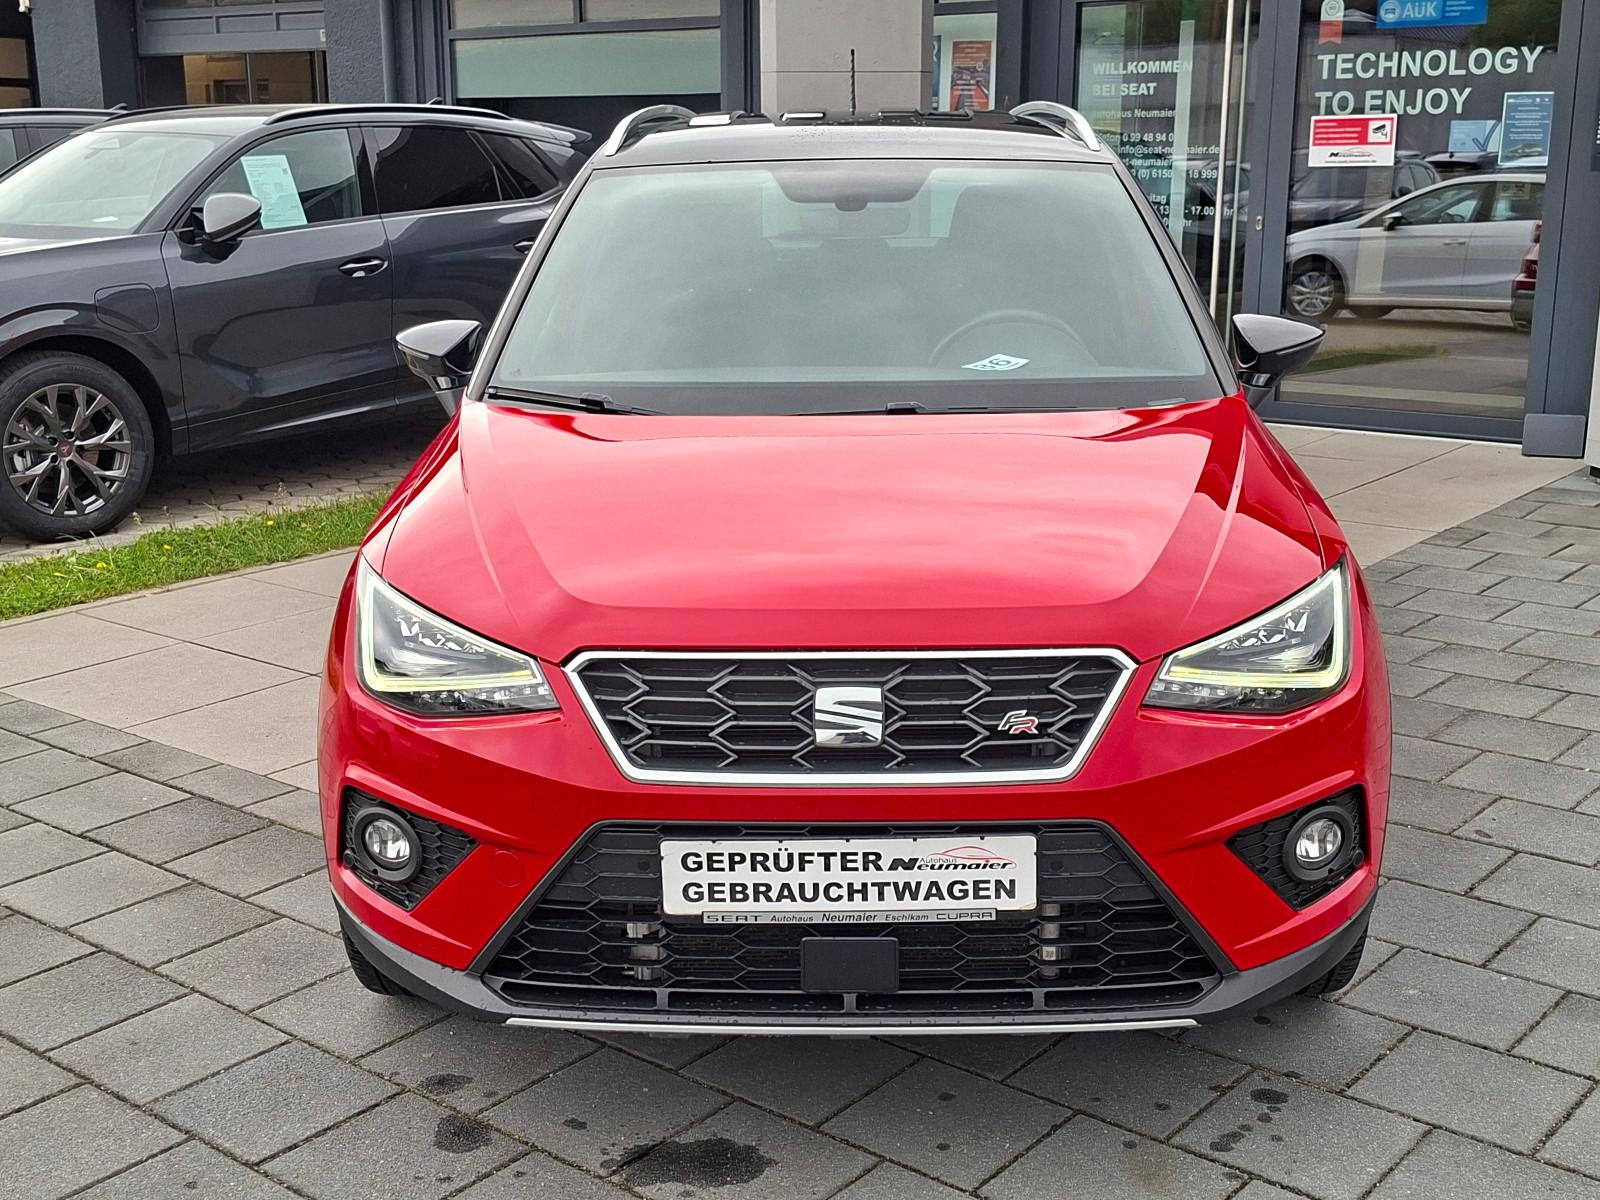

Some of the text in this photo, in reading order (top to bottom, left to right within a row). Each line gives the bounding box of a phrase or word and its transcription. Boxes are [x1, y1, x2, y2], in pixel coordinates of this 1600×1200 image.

[1092, 60, 1193, 75] WILLKOMMEN
[1317, 45, 1544, 80] TECHNOLOGY
[1092, 82, 1158, 96] BEI SEAT
[1315, 87, 1473, 116] TO ENJOY
[1134, 108, 1176, 118] Neumaier
[1155, 132, 1166, 142] 94
[1201, 169, 1218, 178] 999
[1191, 206, 1215, 216] 17.00
[997, 709, 1039, 734] FR
[680, 847, 1013, 873] GEPRÜFTER Neumaier
[681, 878, 1017, 903] GEBRAUCHTWAGEN
[706, 911, 993, 923] SEAT Autohaus Neumaier Eschlkam CUPRA
